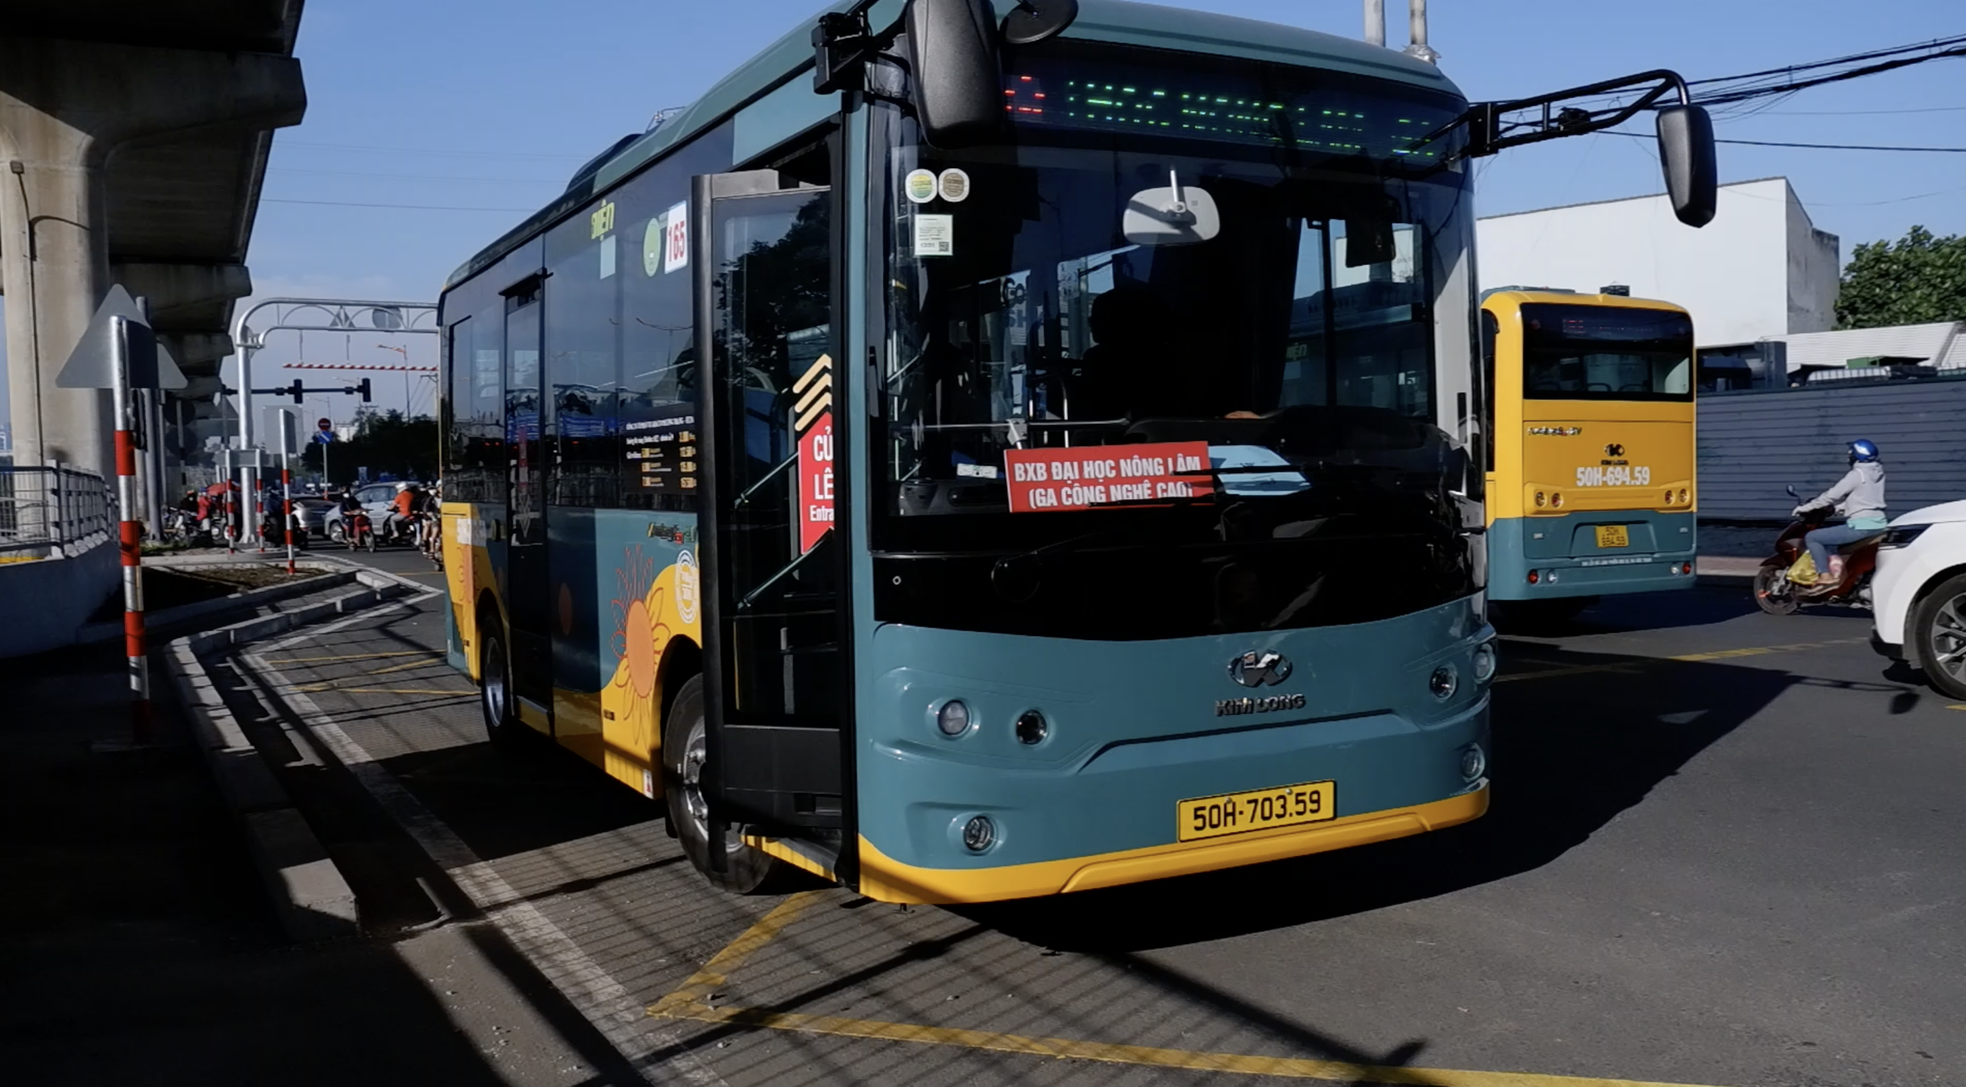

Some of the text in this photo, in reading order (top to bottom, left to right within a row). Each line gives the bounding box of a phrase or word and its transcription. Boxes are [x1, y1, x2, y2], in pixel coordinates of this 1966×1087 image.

[668, 220, 685, 262] 165
[1014, 462, 1047, 482] BXB
[1051, 461, 1080, 484] ĐẠI
[1083, 459, 1116, 482] HỌC
[1120, 455, 1164, 478] NÔNG
[1576, 466, 1650, 487] 50H-694.59
[1029, 487, 1058, 509] (GA
[1061, 483, 1106, 506] CÔNG
[1215, 693, 1307, 717] KIM LONG
[1193, 790, 1321, 831] 50H-703.59
